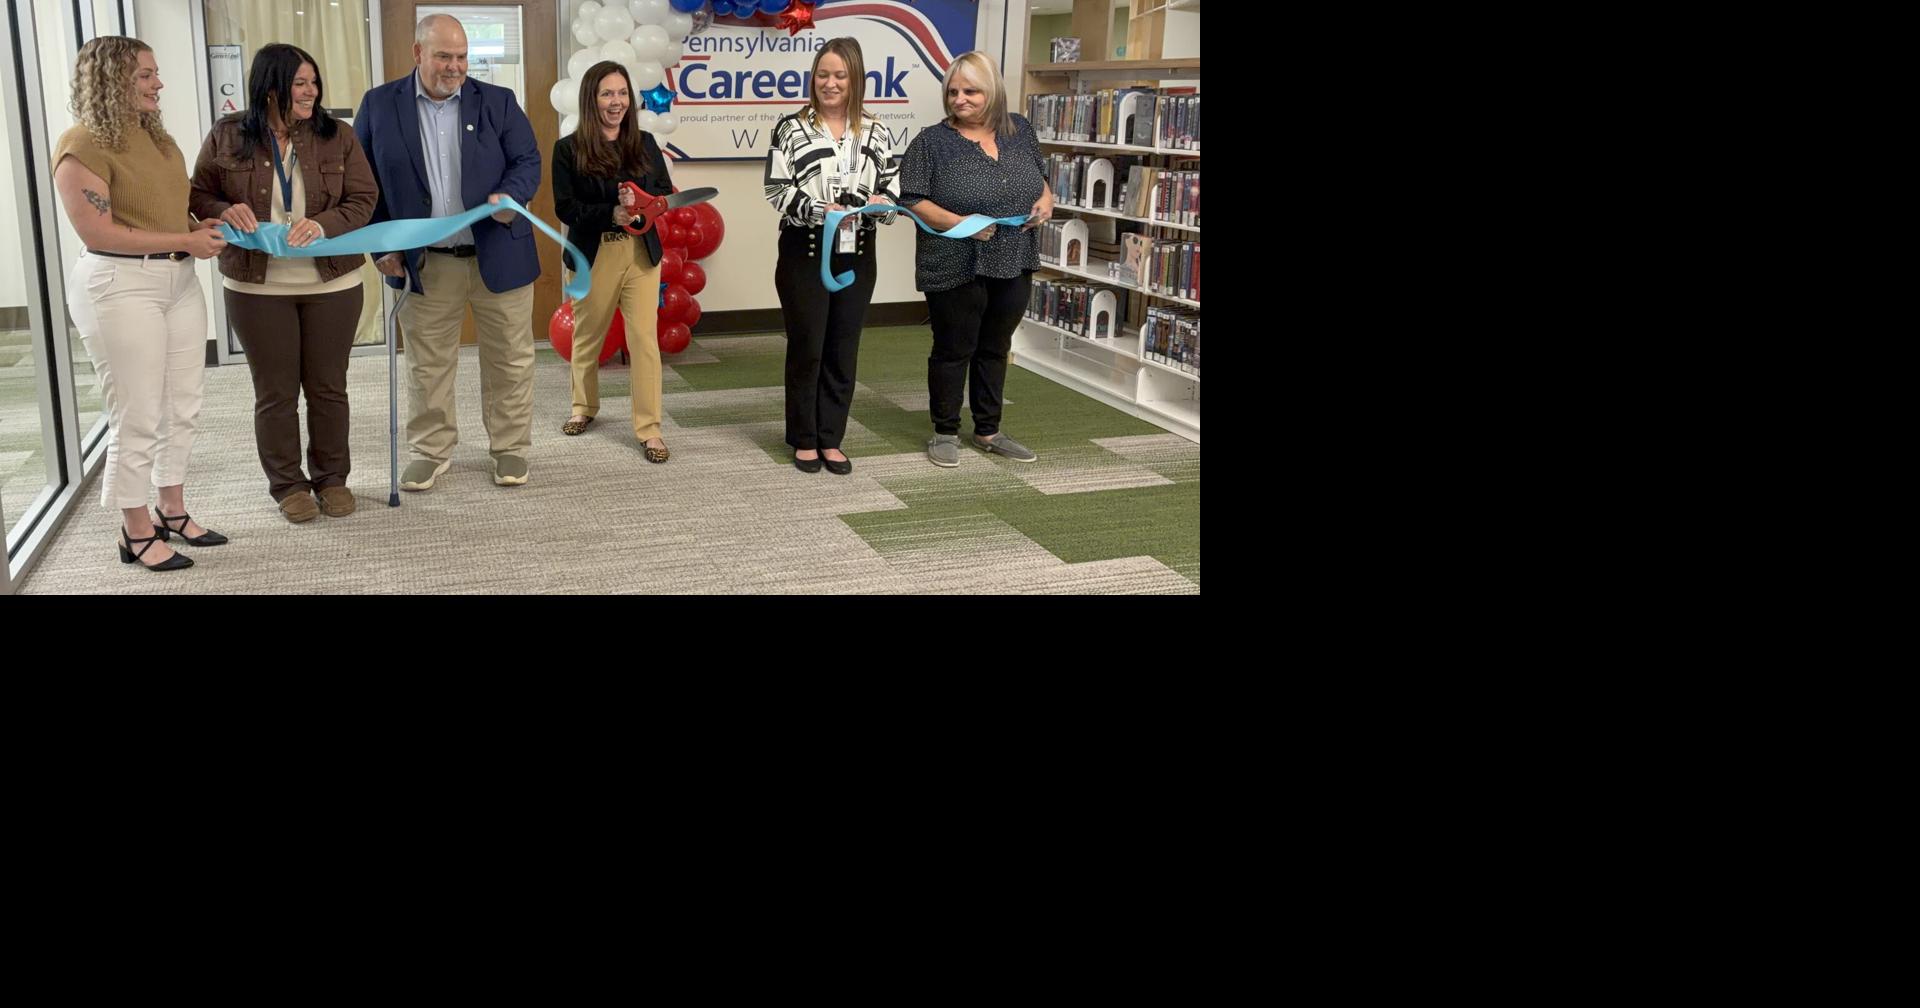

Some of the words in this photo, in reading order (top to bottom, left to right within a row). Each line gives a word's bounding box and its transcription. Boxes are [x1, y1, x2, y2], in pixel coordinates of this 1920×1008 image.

[682, 31, 827, 59] ennsylvania
[680, 114, 708, 122] proud
[710, 113, 745, 123] partner
[747, 113, 758, 121] of
[760, 112, 775, 121] the
[879, 112, 916, 120] network
